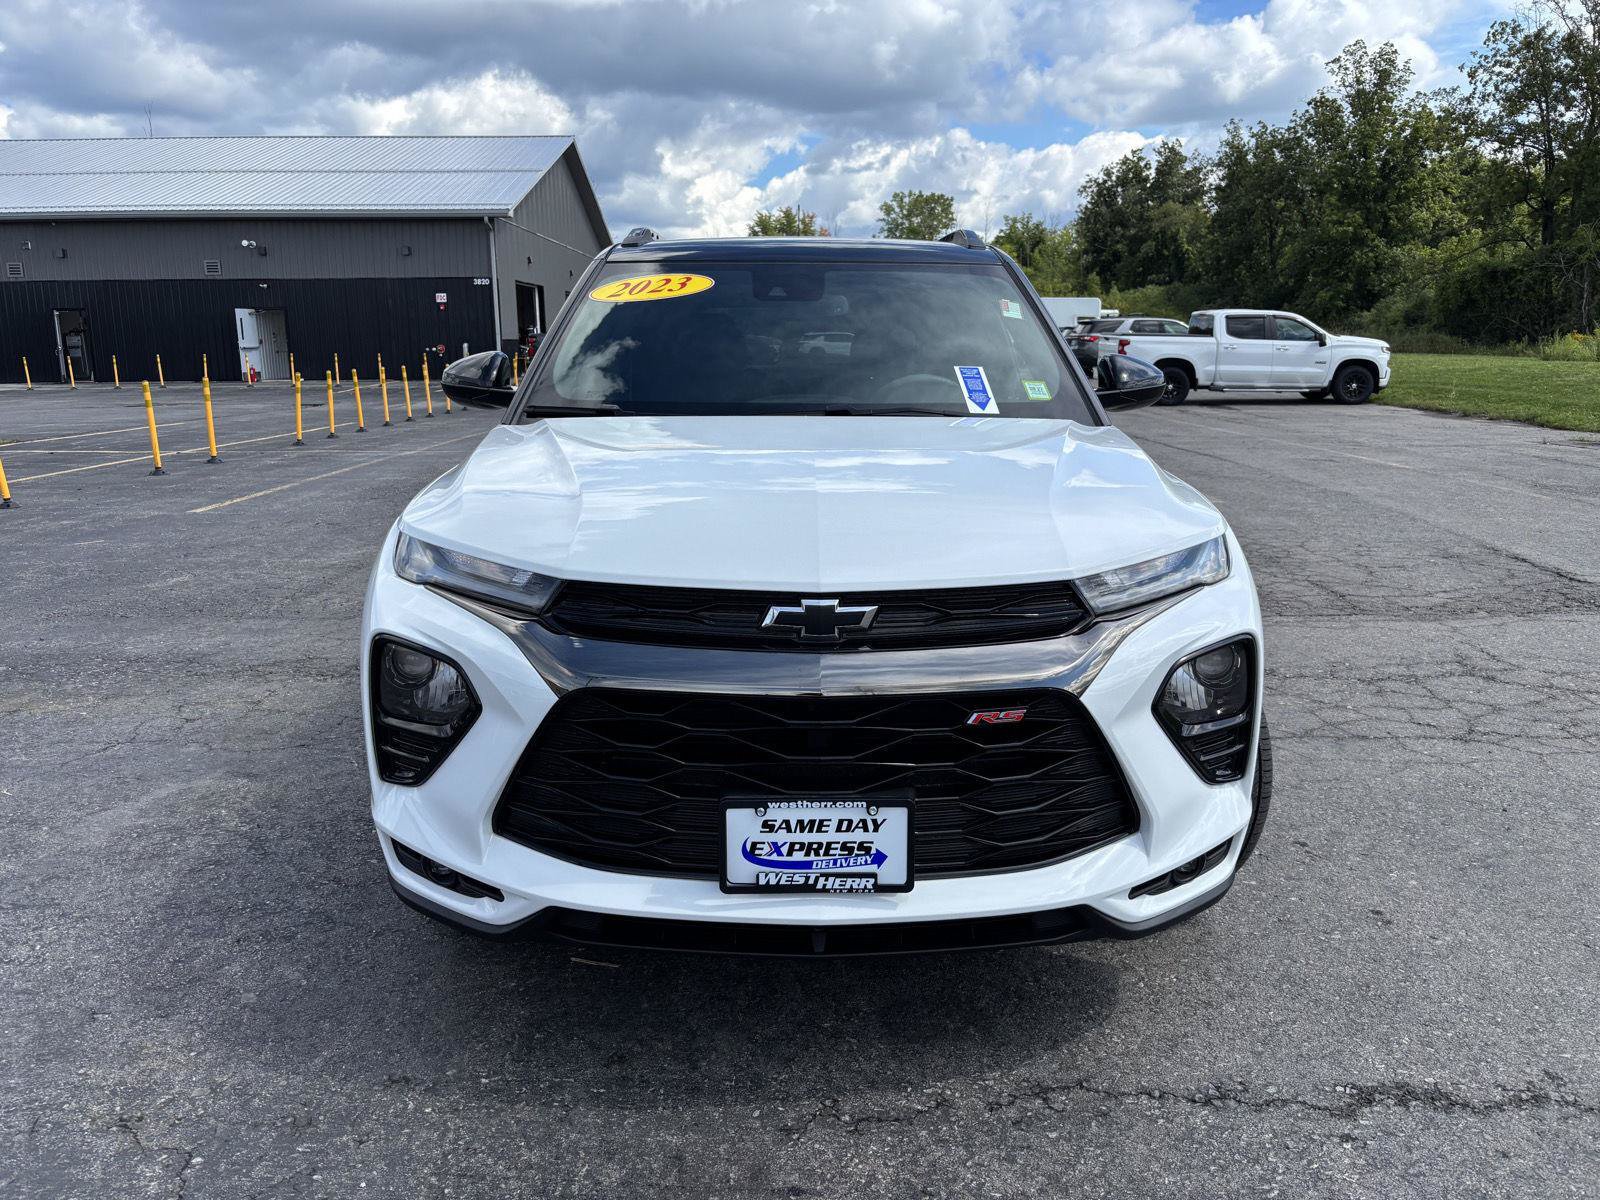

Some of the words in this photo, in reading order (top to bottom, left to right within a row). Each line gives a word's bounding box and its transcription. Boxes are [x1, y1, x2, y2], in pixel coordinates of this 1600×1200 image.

[606, 276, 693, 299] 2023
[966, 709, 1027, 724] RS
[767, 800, 867, 809] westherr.com
[760, 818, 831, 834] SAME
[835, 818, 888, 833] DAY
[749, 841, 874, 857] EXPRESS
[812, 854, 875, 870] DELIVERY
